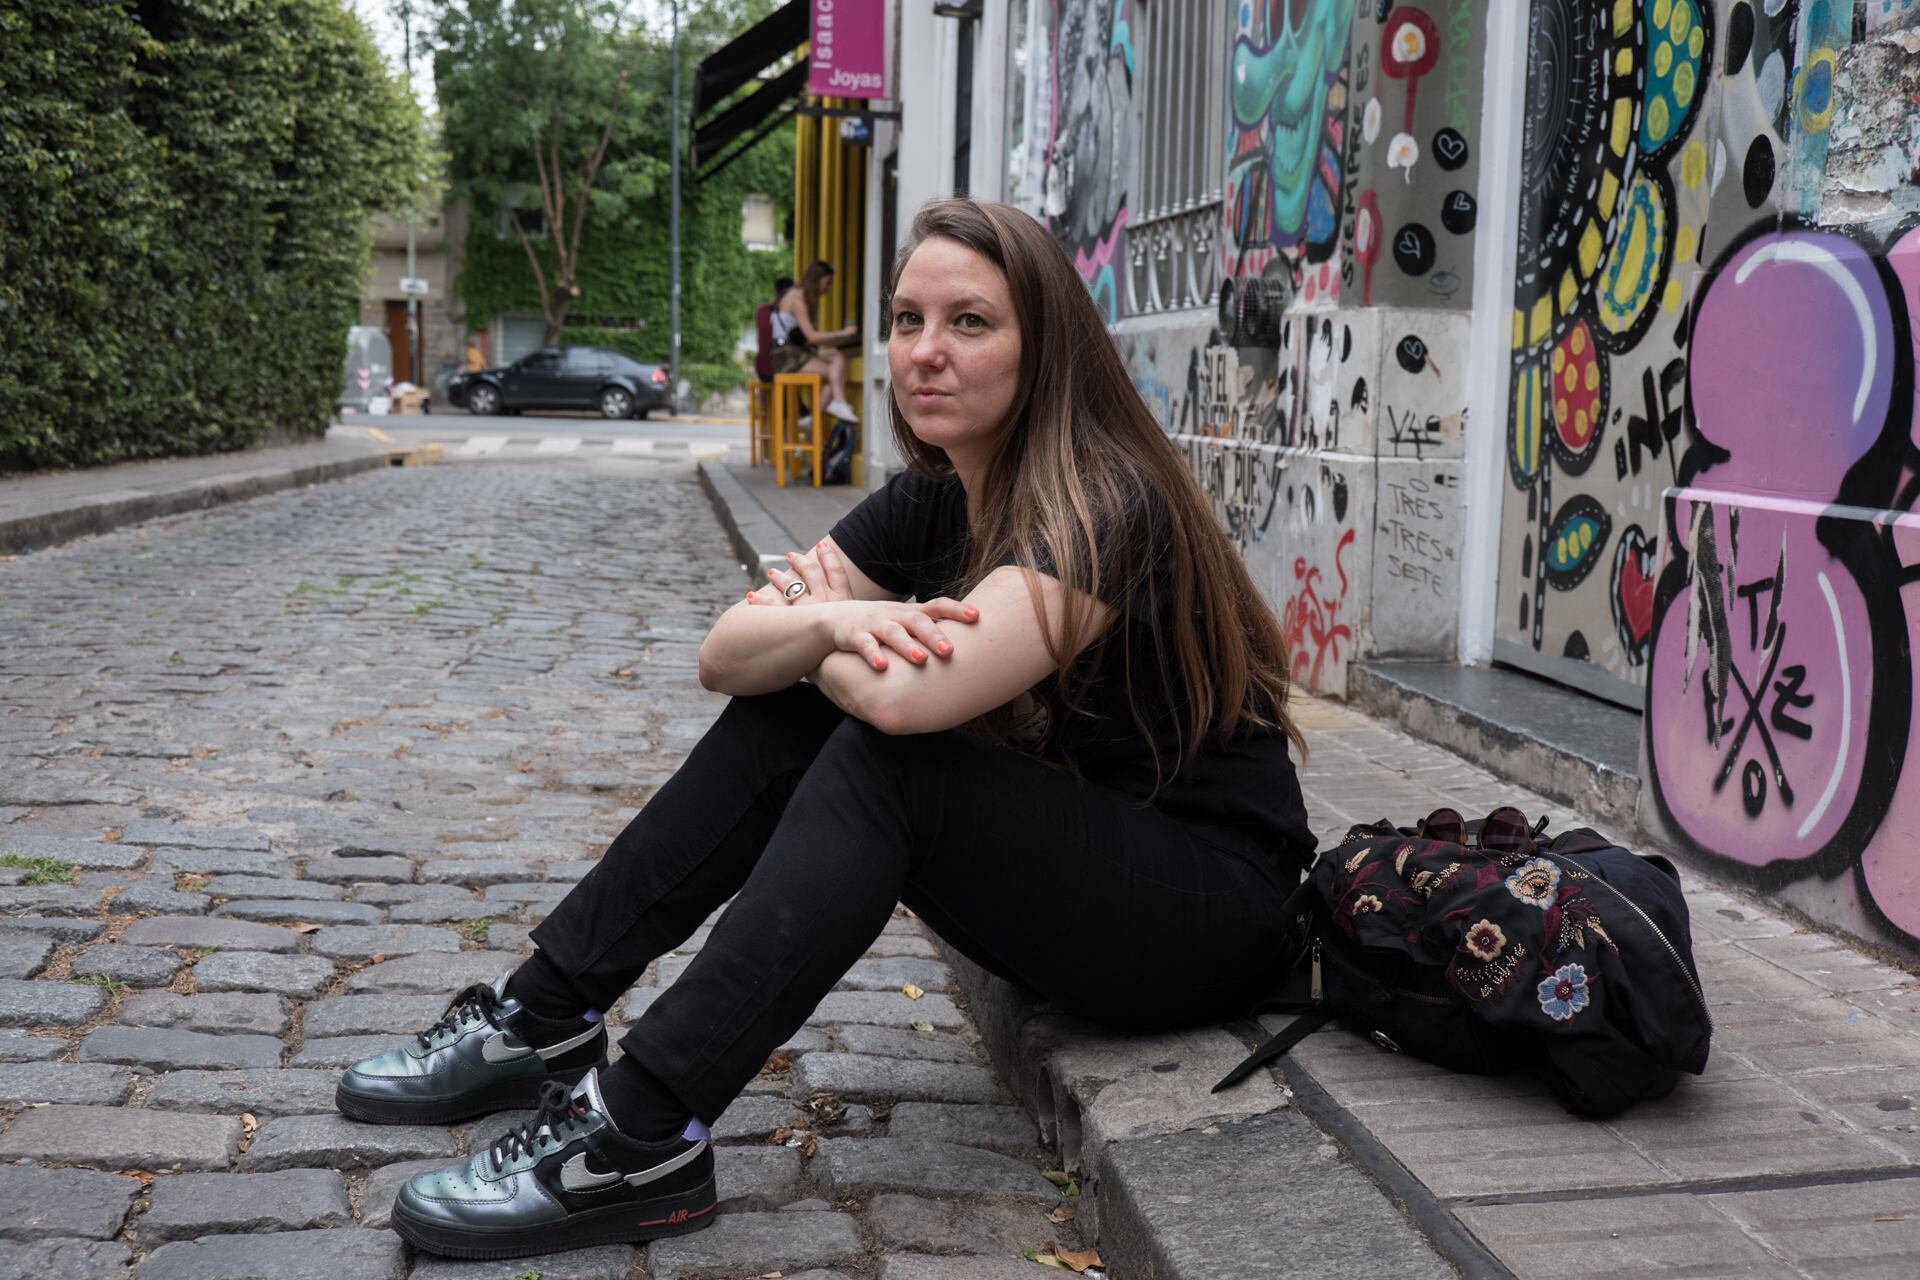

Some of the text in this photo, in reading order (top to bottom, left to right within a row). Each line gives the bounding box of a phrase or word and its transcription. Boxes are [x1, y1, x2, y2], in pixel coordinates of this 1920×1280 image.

[828, 68, 882, 90] Joyas
[1387, 483, 1443, 520] TRES
[1388, 554, 1442, 597] SETE
[667, 1208, 688, 1224] AIR
